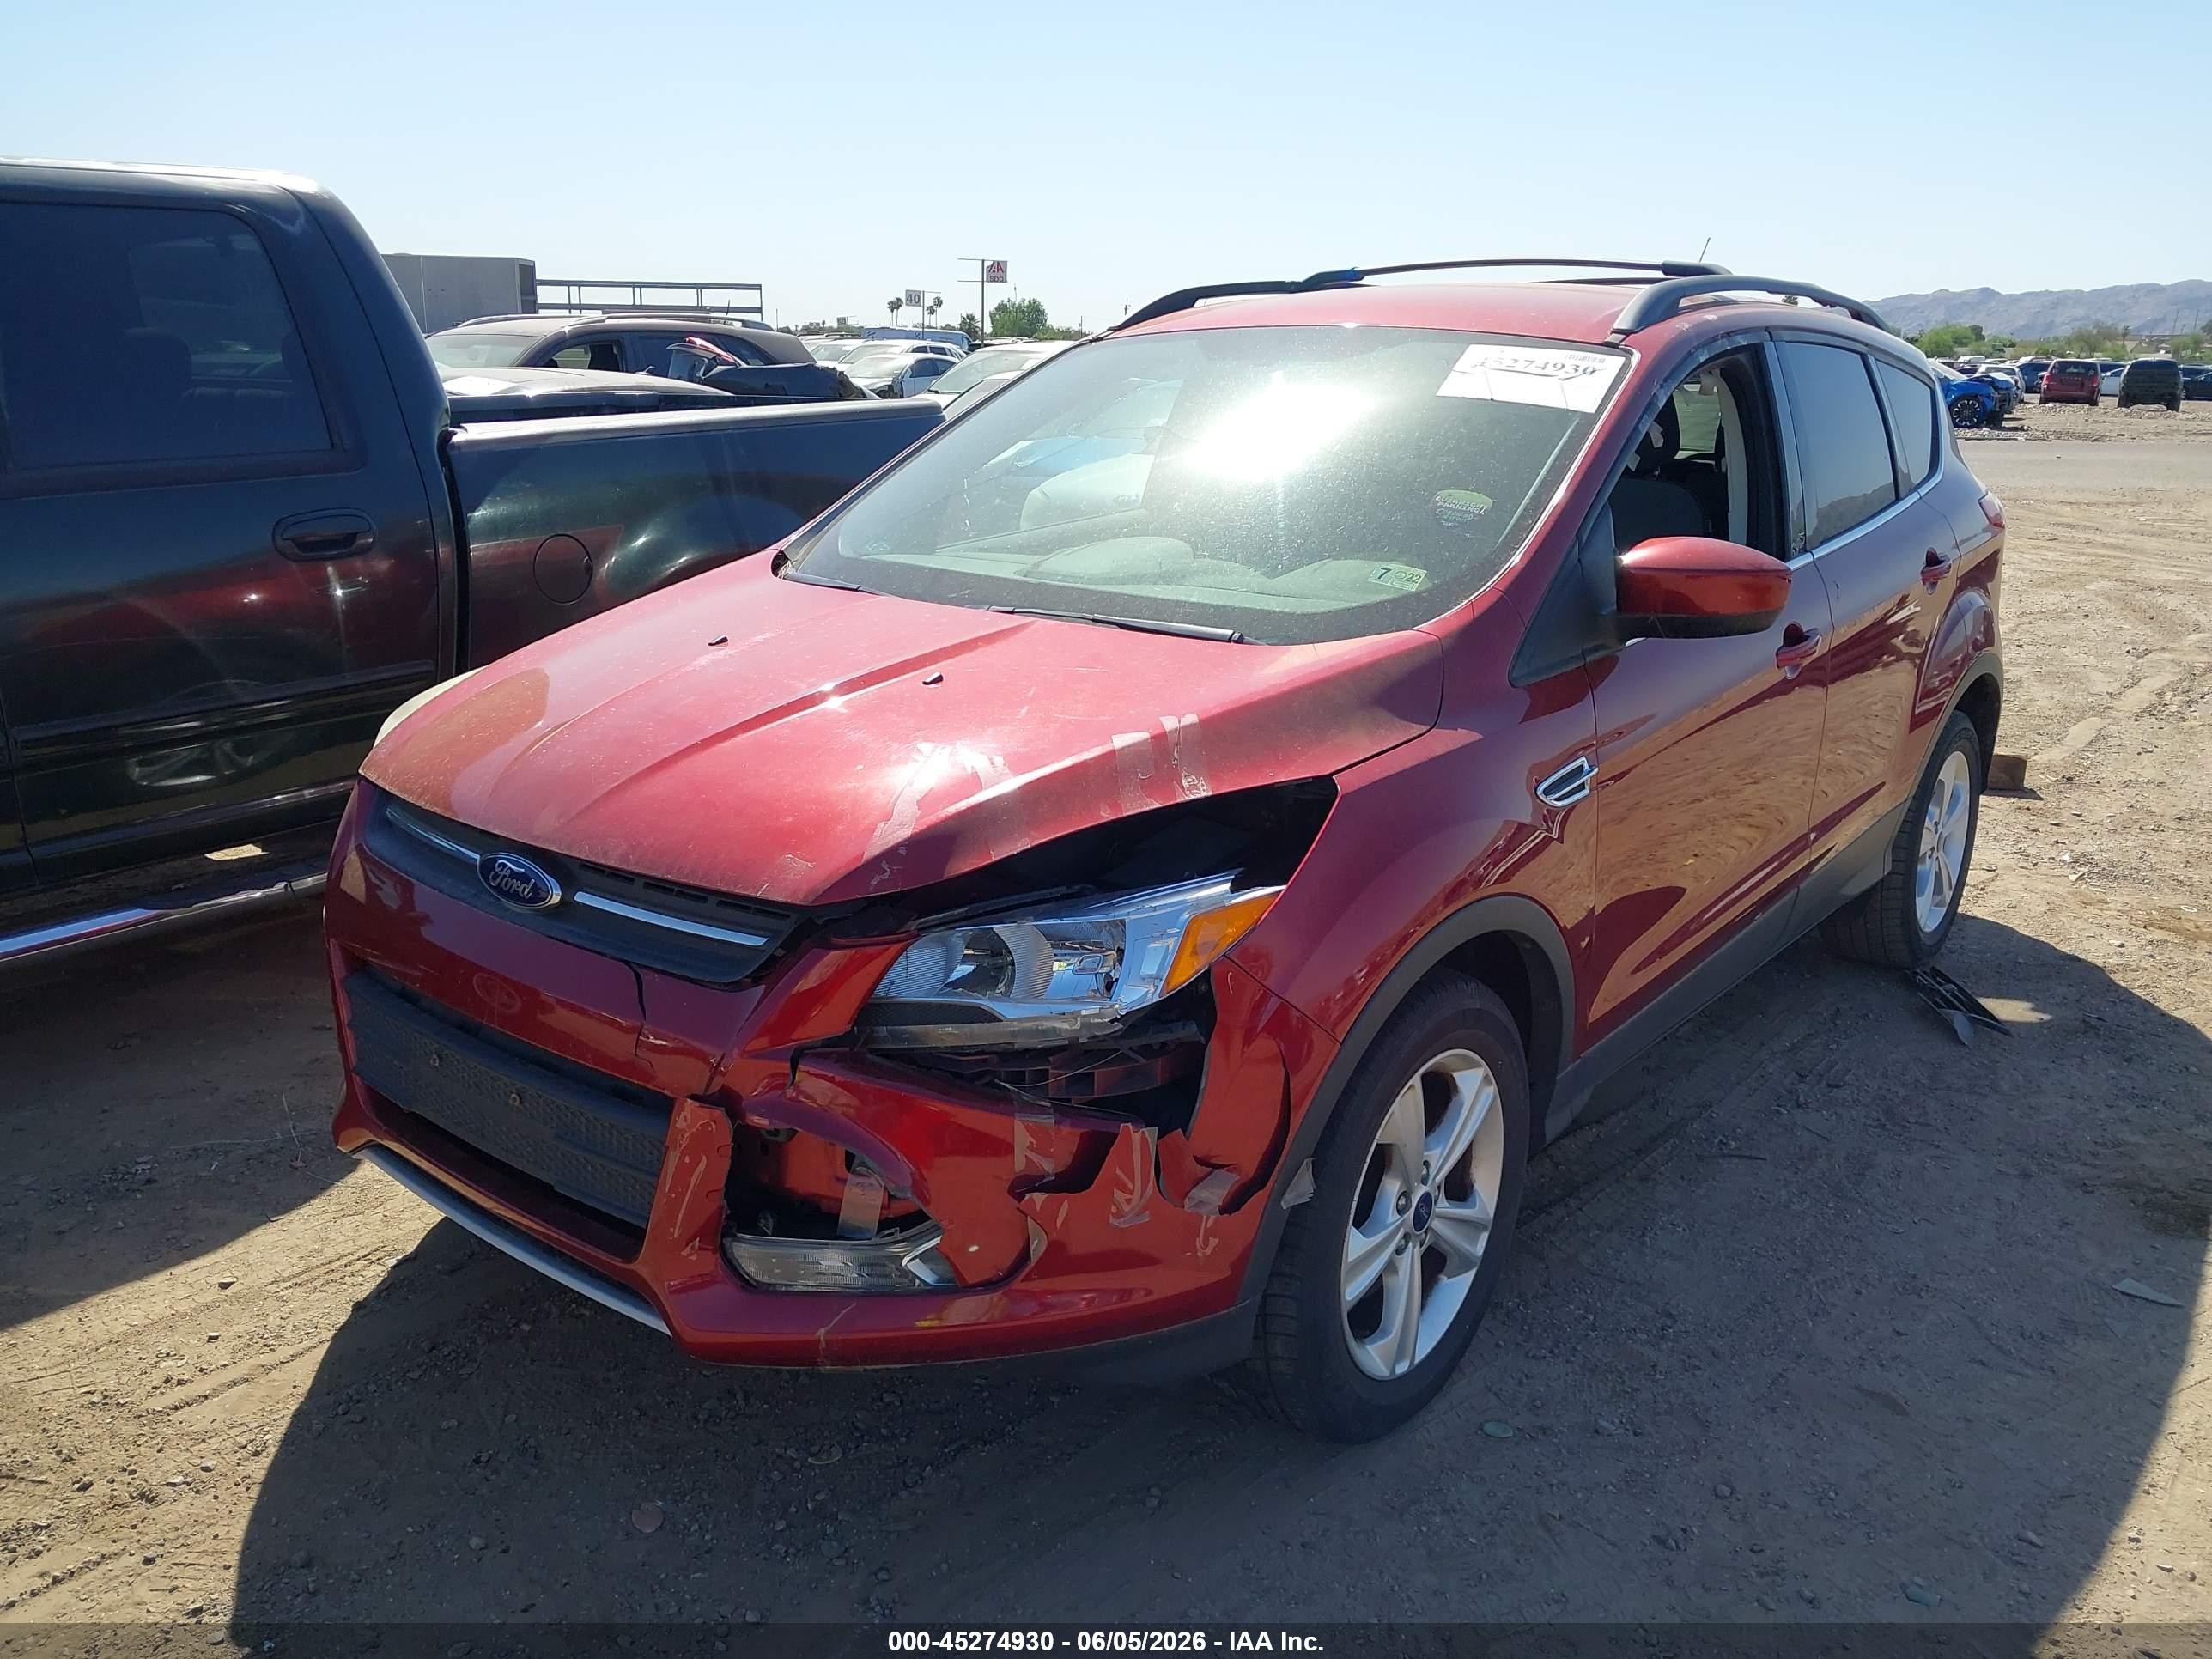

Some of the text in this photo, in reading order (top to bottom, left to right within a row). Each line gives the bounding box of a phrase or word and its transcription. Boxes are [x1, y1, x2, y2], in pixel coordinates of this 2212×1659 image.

[907, 294, 921, 304] 40
[1377, 567, 1393, 580] 7
[489, 860, 535, 899] Ford
